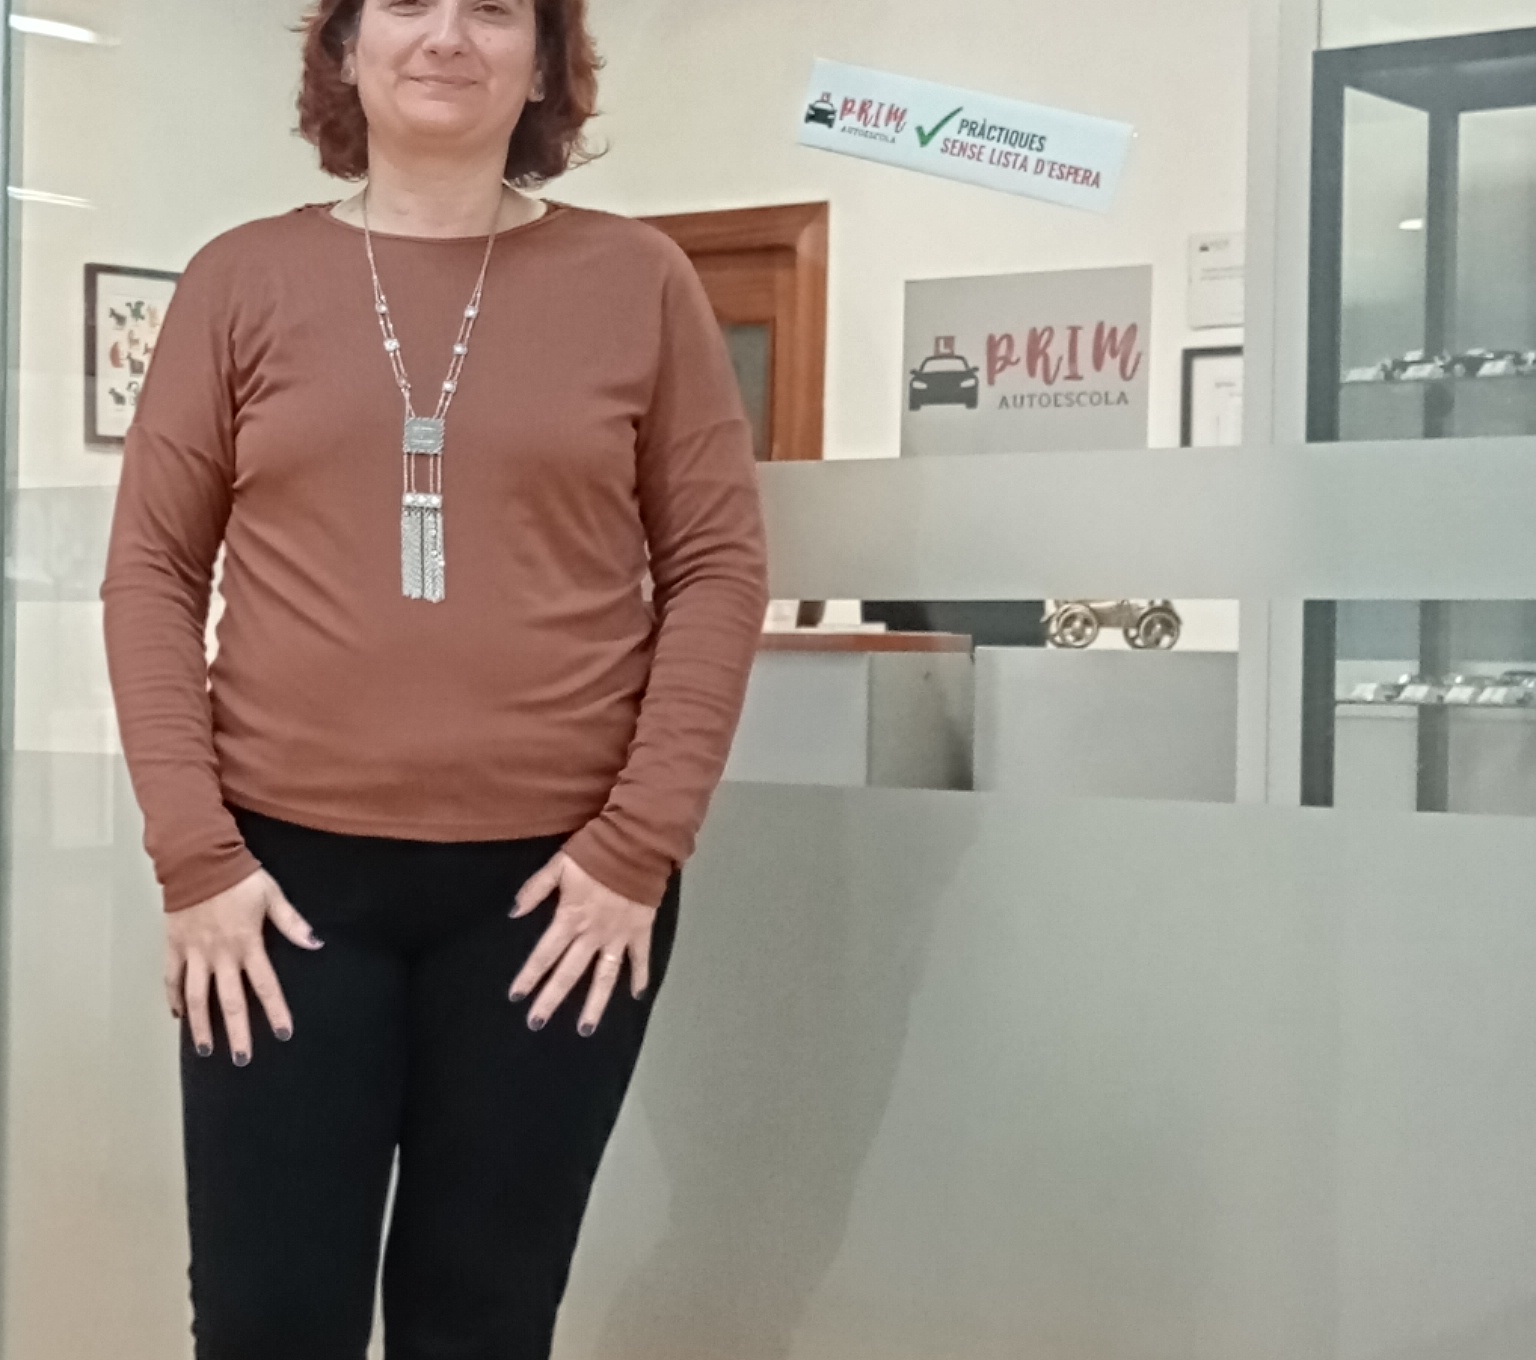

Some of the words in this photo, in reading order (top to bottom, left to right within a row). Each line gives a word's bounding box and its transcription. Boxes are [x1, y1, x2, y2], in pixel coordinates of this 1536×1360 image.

[839, 95, 909, 134] PRIM
[957, 117, 1047, 153] PRÀCTIQUES
[940, 137, 985, 163] SENSE
[988, 147, 1028, 173] LISTA
[1033, 157, 1101, 189] D'ESPERA
[985, 320, 1143, 386] PRIM
[998, 390, 1129, 411] AUTOESCOLA
